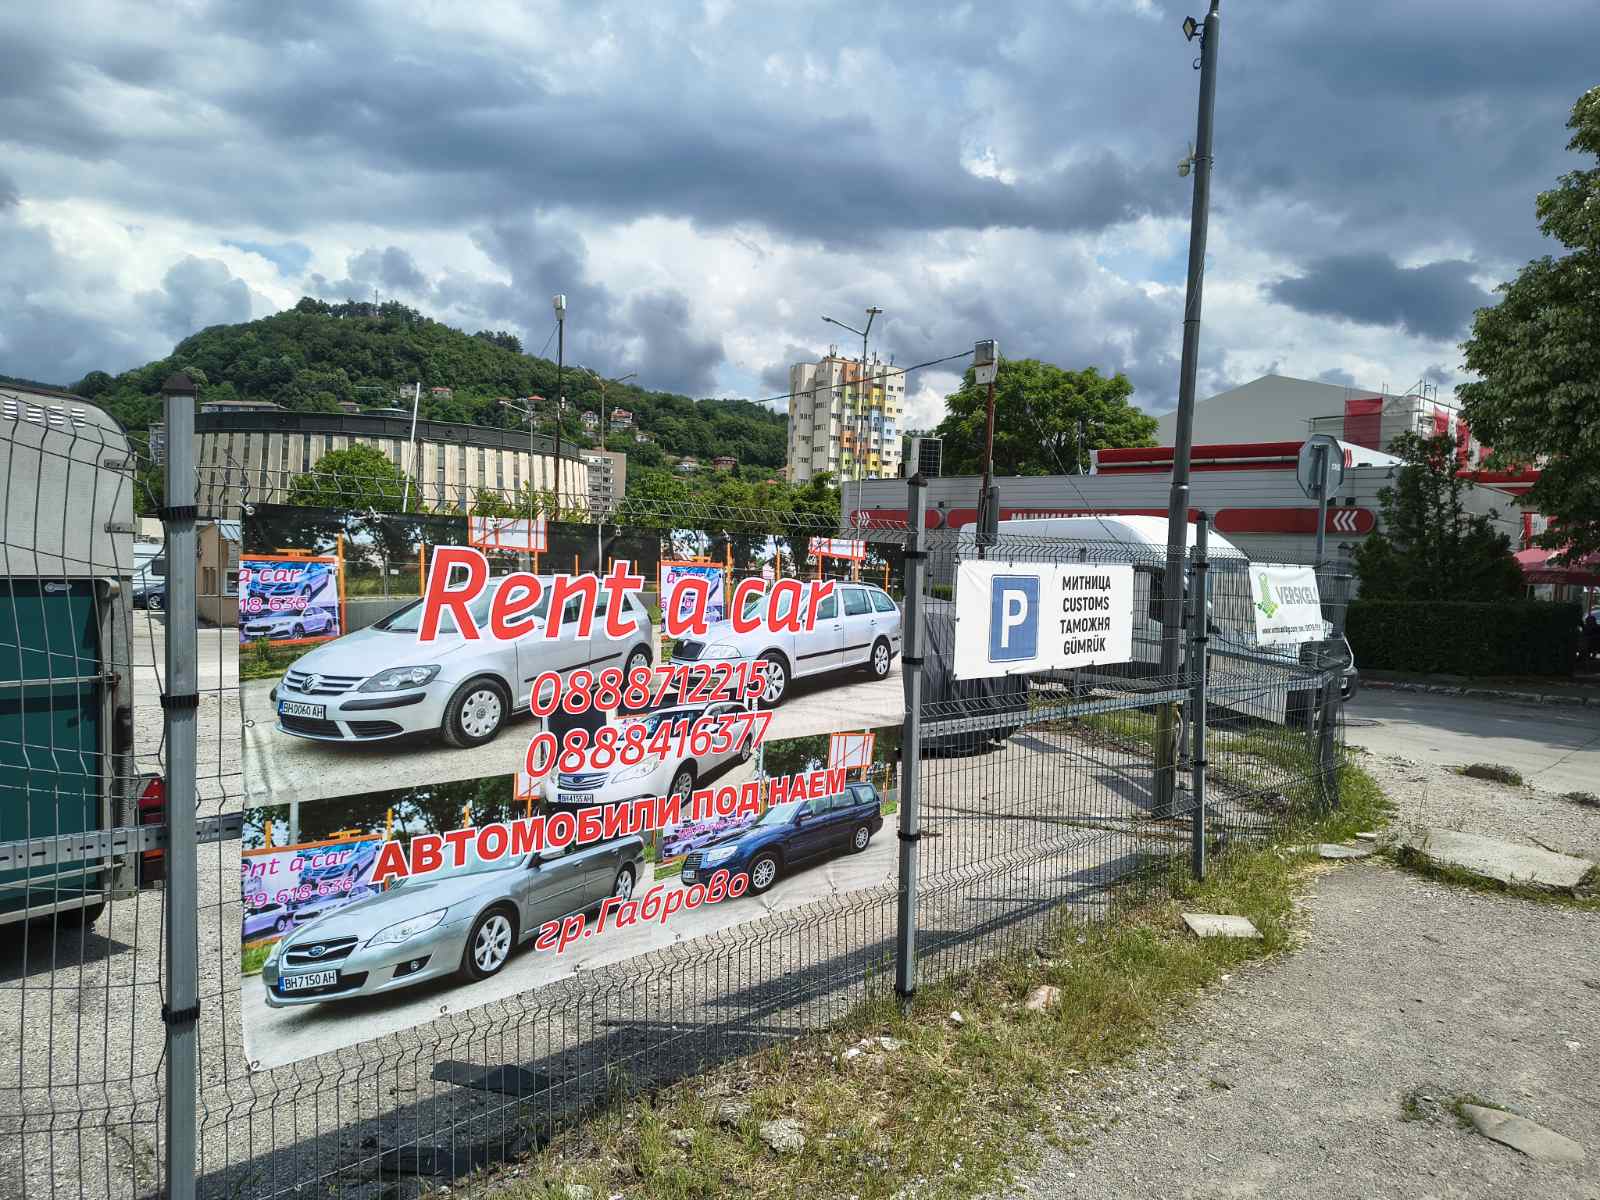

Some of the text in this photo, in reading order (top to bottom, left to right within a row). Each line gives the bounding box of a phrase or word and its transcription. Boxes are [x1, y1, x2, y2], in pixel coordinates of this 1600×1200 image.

[260, 568, 303, 582] car
[1062, 575, 1111, 592] МИТНИЦА
[418, 547, 835, 642] Rent a car
[1063, 596, 1110, 612] CUSTOMS
[1001, 589, 1028, 648] P
[1060, 617, 1110, 634] ТАМОЖНЯ
[1063, 636, 1106, 655] GÜMRÜK
[531, 661, 768, 717] 0888712215
[526, 711, 772, 776] 0888416377
[369, 795, 681, 884] АВТОМОБИЛИ
[692, 782, 760, 820] ПОД
[768, 768, 847, 807] НАЕМ
[289, 857, 304, 872] a
[312, 850, 351, 868] car
[276, 884, 312, 904] 618
